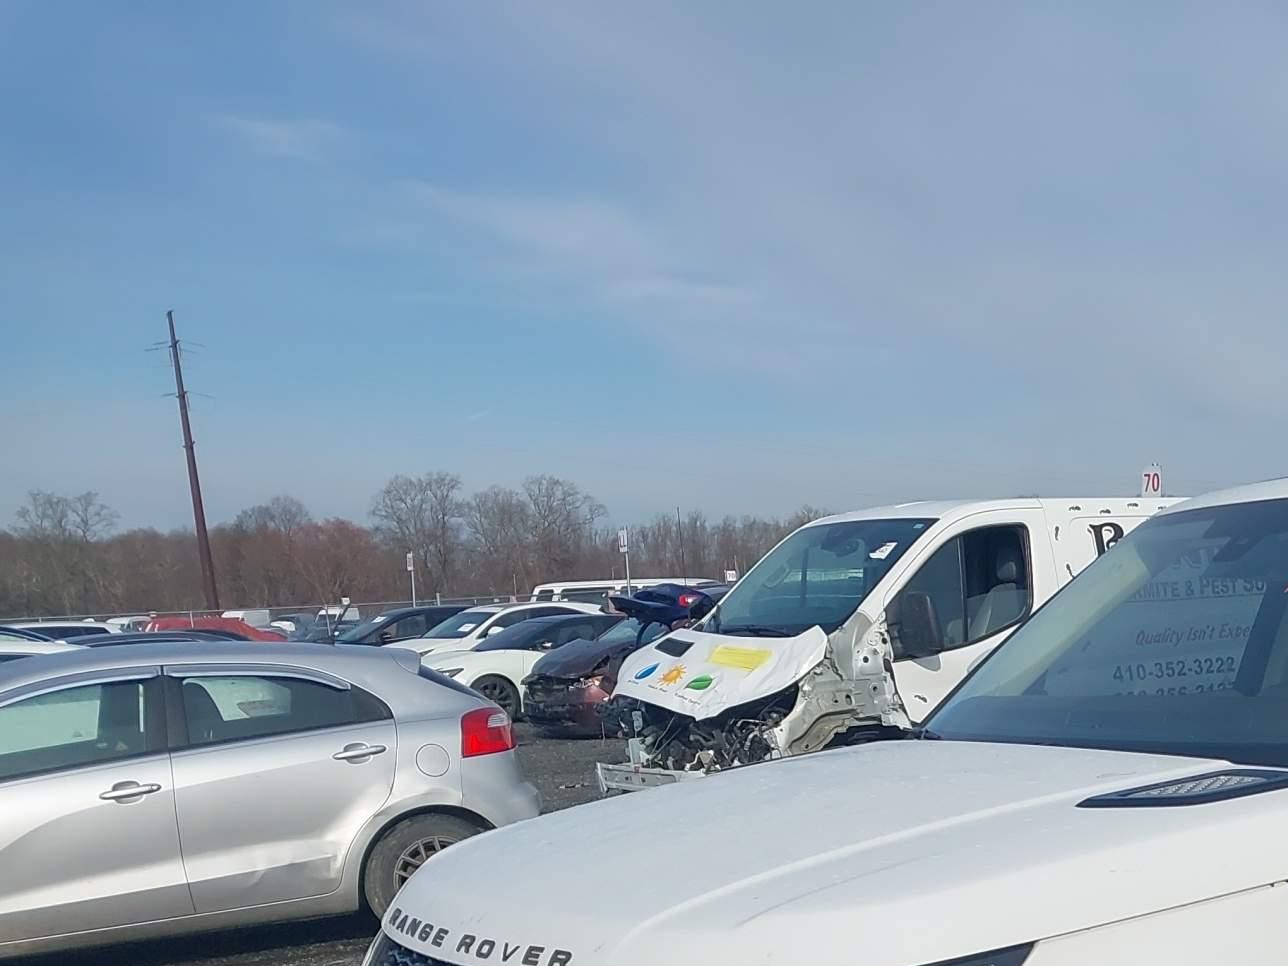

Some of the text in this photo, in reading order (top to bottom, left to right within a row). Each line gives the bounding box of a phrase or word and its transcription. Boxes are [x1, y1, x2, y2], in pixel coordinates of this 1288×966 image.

[1143, 472, 1161, 493] 70
[1200, 577, 1241, 596] PEST
[1135, 627, 1184, 647] Quality
[1187, 624, 1216, 641] Isn't
[1112, 656, 1236, 682] 410-352-3222
[388, 907, 450, 948] RANGE
